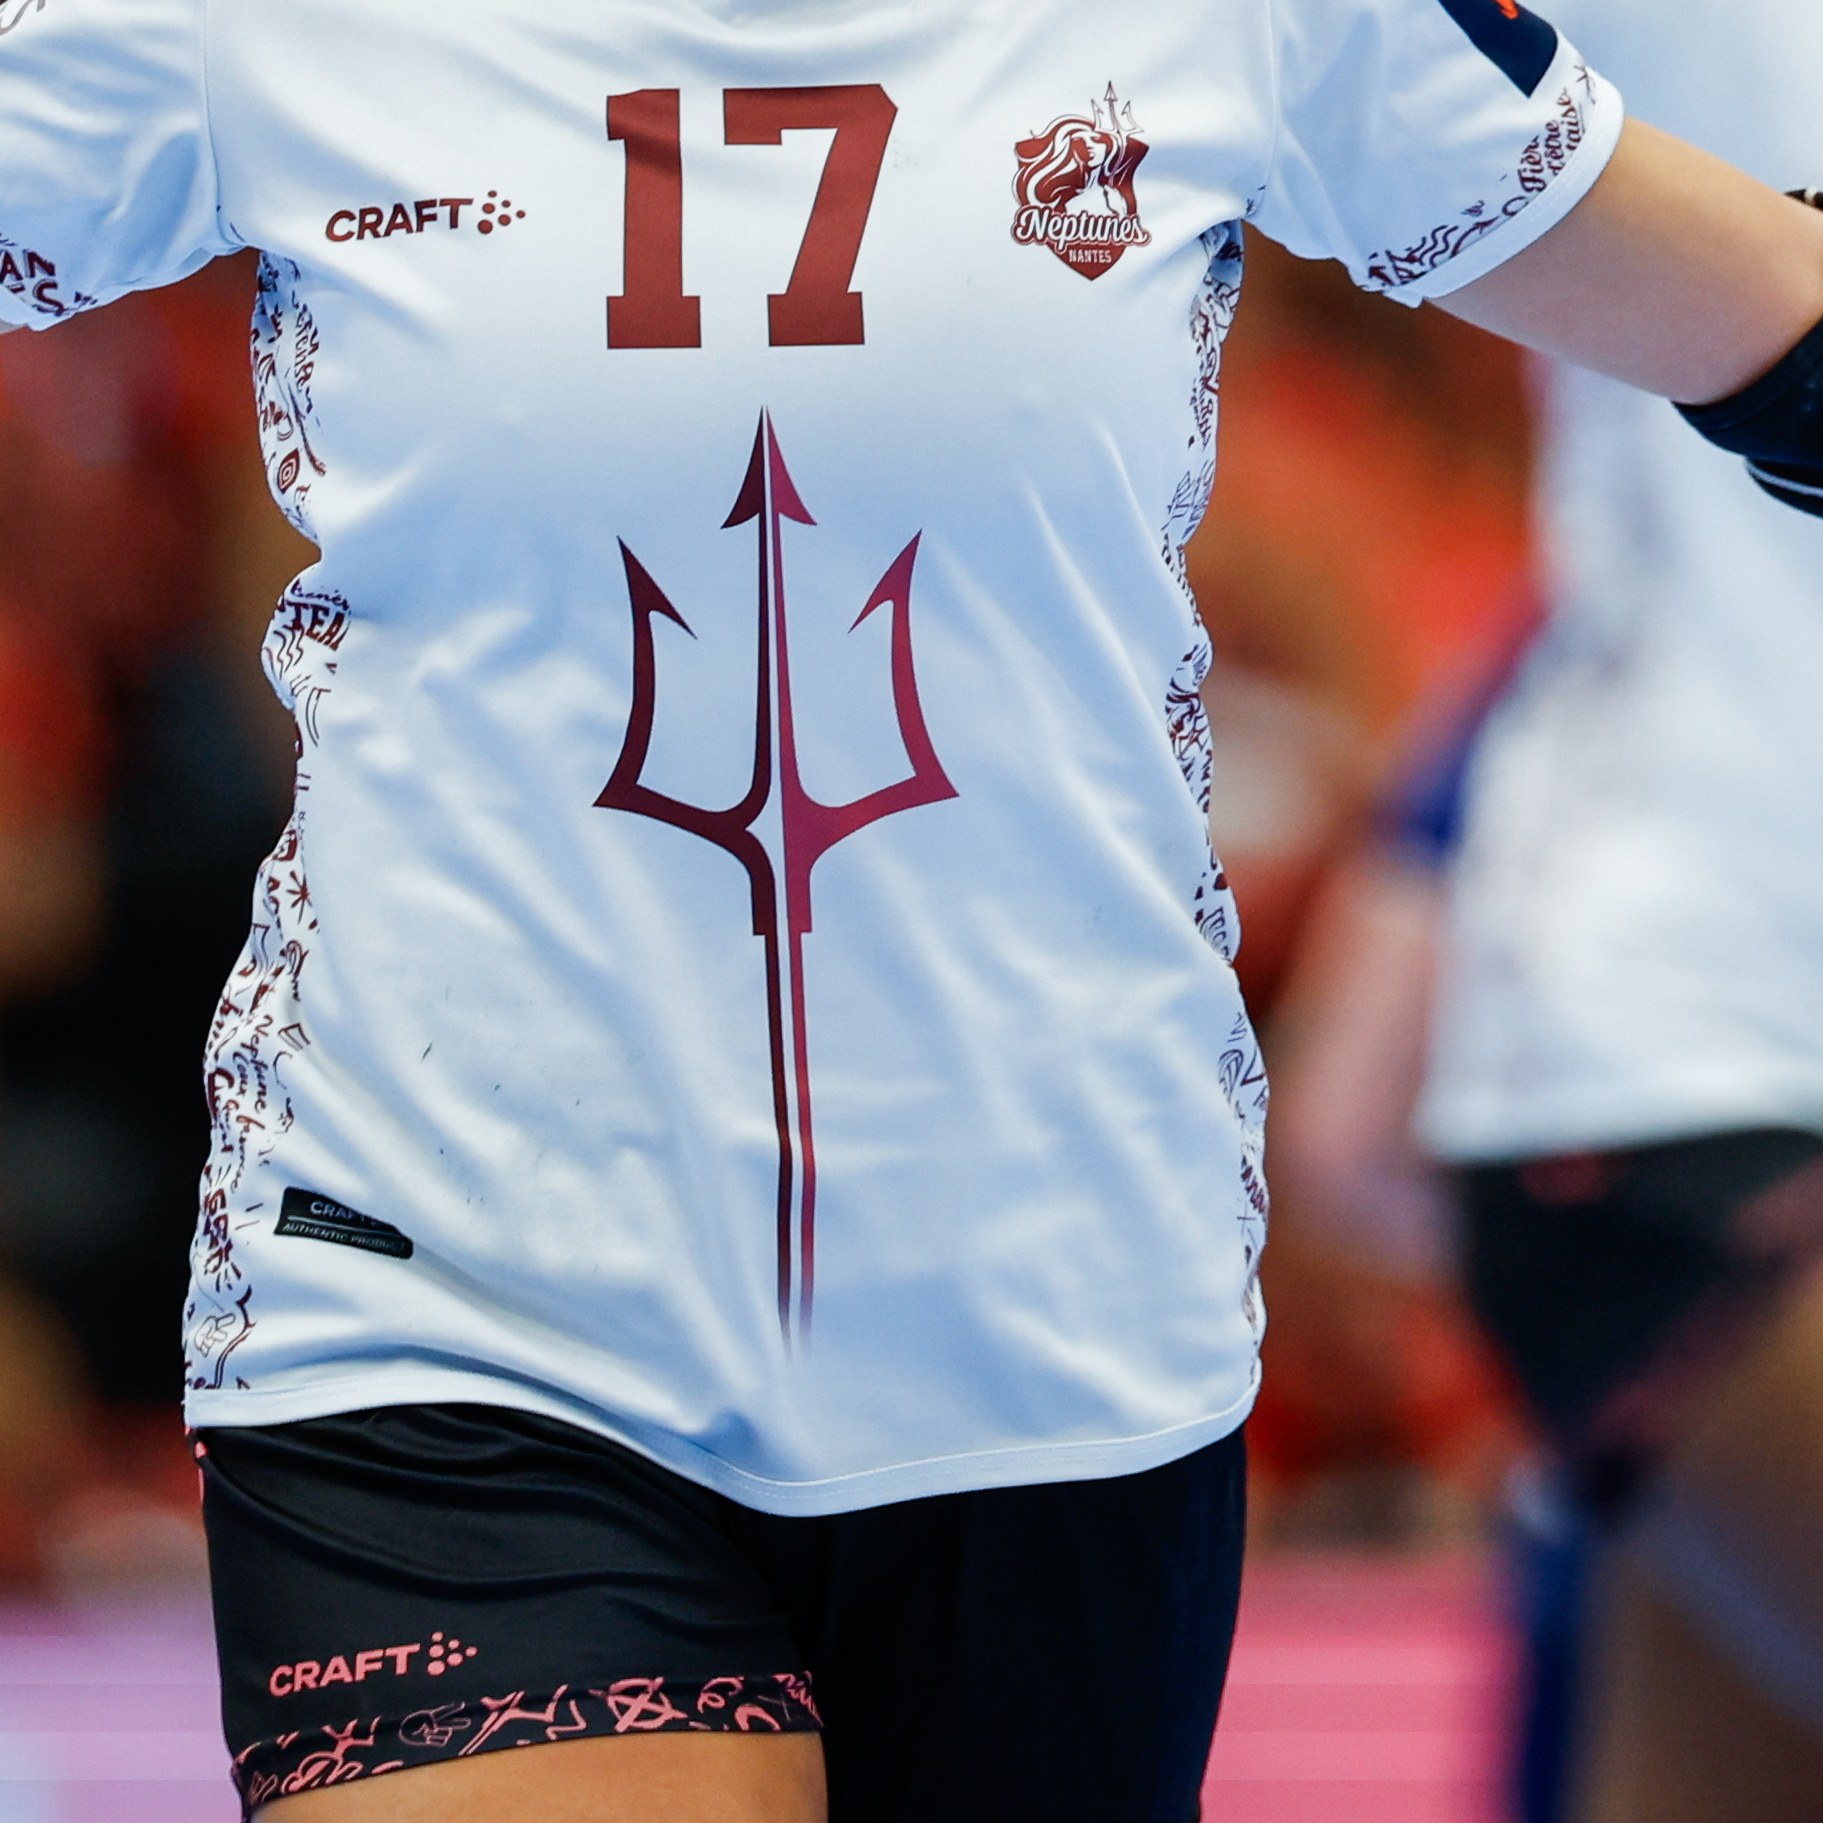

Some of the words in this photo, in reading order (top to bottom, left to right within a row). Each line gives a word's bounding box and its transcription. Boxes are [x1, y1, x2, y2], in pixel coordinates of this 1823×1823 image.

[326, 198, 474, 242] CRAFT
[606, 84, 898, 349] 17
[1014, 206, 1150, 253] Neptunes
[1068, 249, 1112, 263] NANTES
[282, 1222, 348, 1243] AUTHENTIC
[269, 1642, 421, 1696] CRAFT
